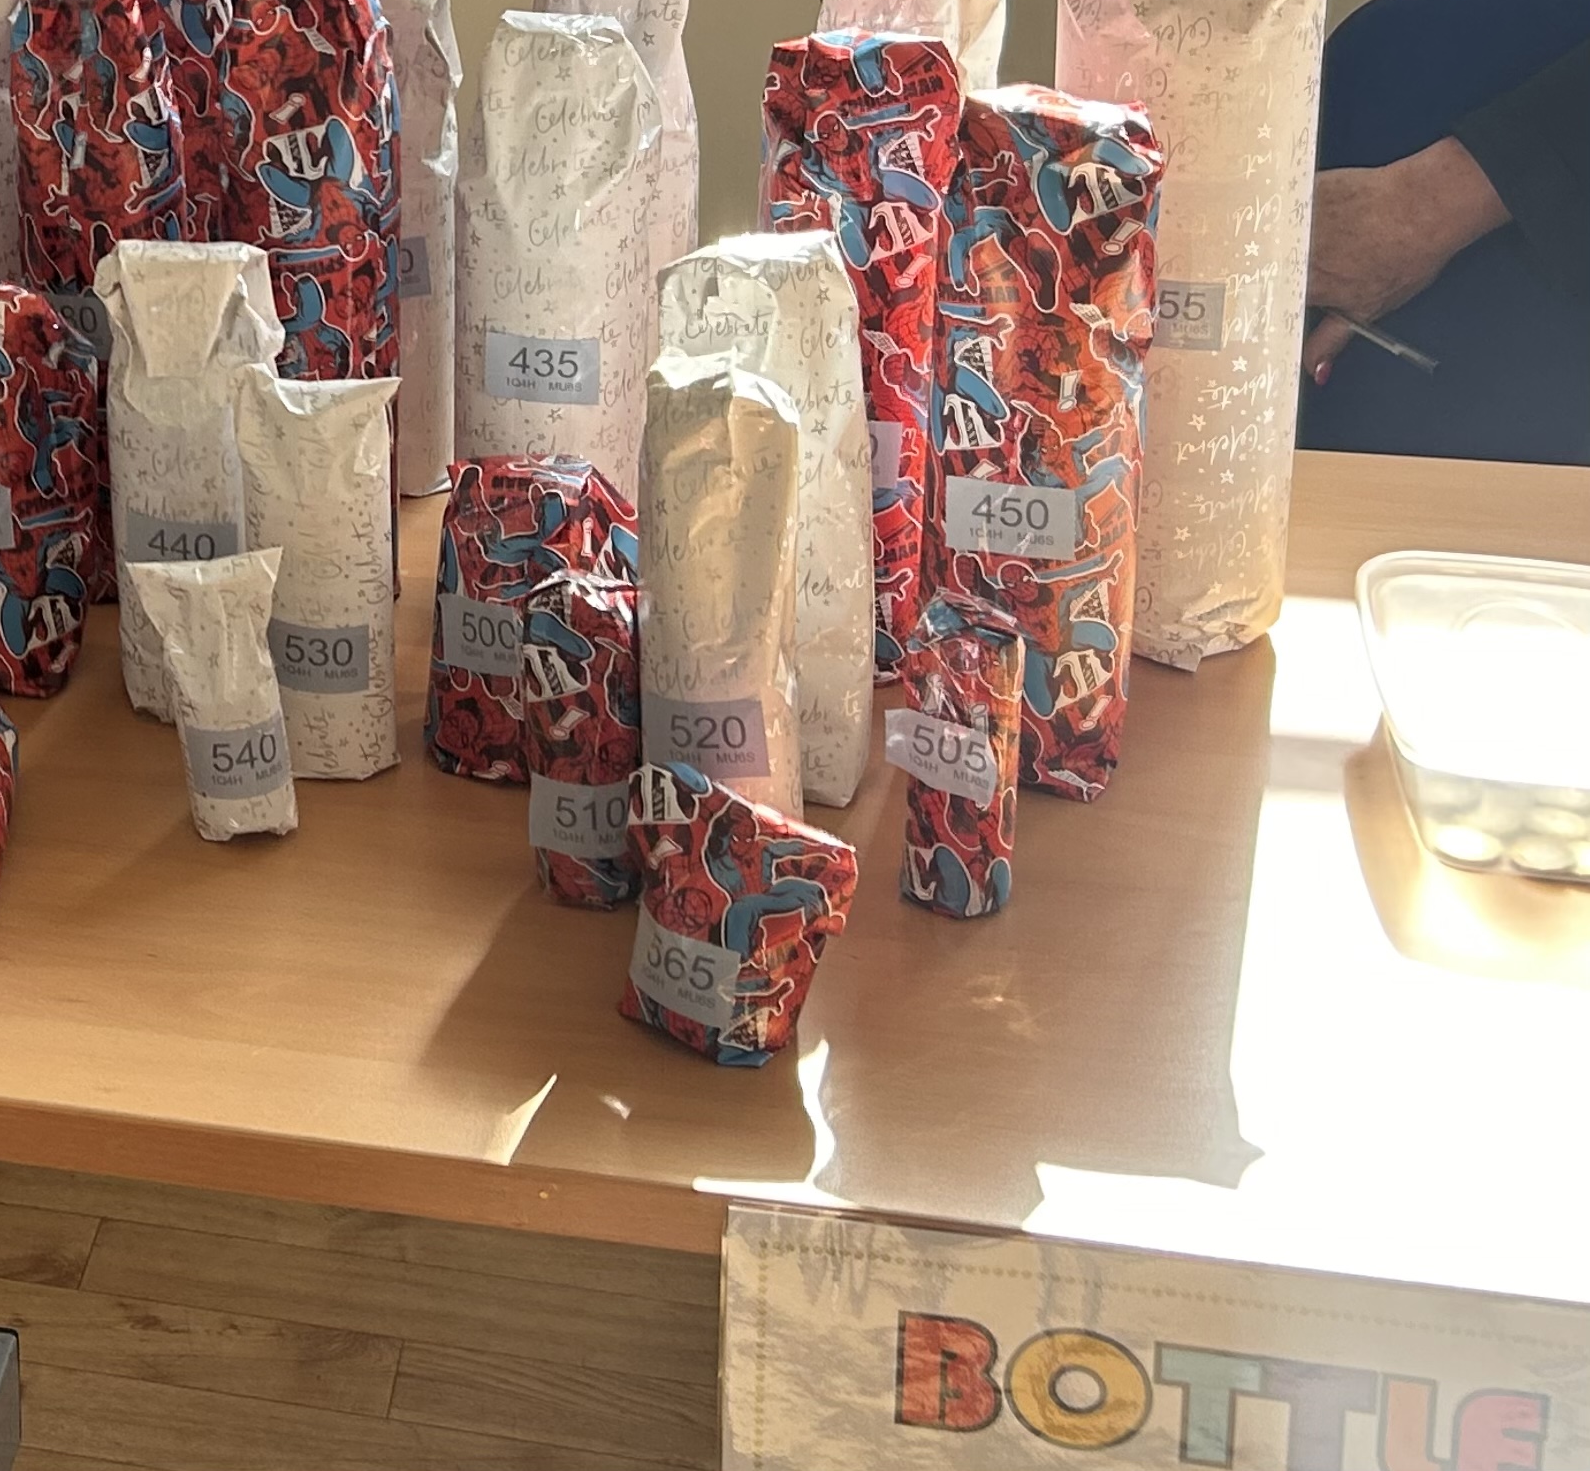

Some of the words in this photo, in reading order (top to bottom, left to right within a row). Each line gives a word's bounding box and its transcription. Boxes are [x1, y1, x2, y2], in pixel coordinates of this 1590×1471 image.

[1158, 289, 1207, 322] 55
[507, 346, 579, 379] 435
[971, 493, 1050, 531] 450
[146, 528, 216, 562] 440
[461, 610, 516, 650] 500
[285, 633, 354, 667] 530
[670, 714, 747, 749] 520
[912, 723, 988, 773] 505
[211, 733, 277, 773] 540
[554, 794, 627, 832] 510
[645, 931, 716, 992] 565
[894, 1309, 1551, 1471] BOTTLE
